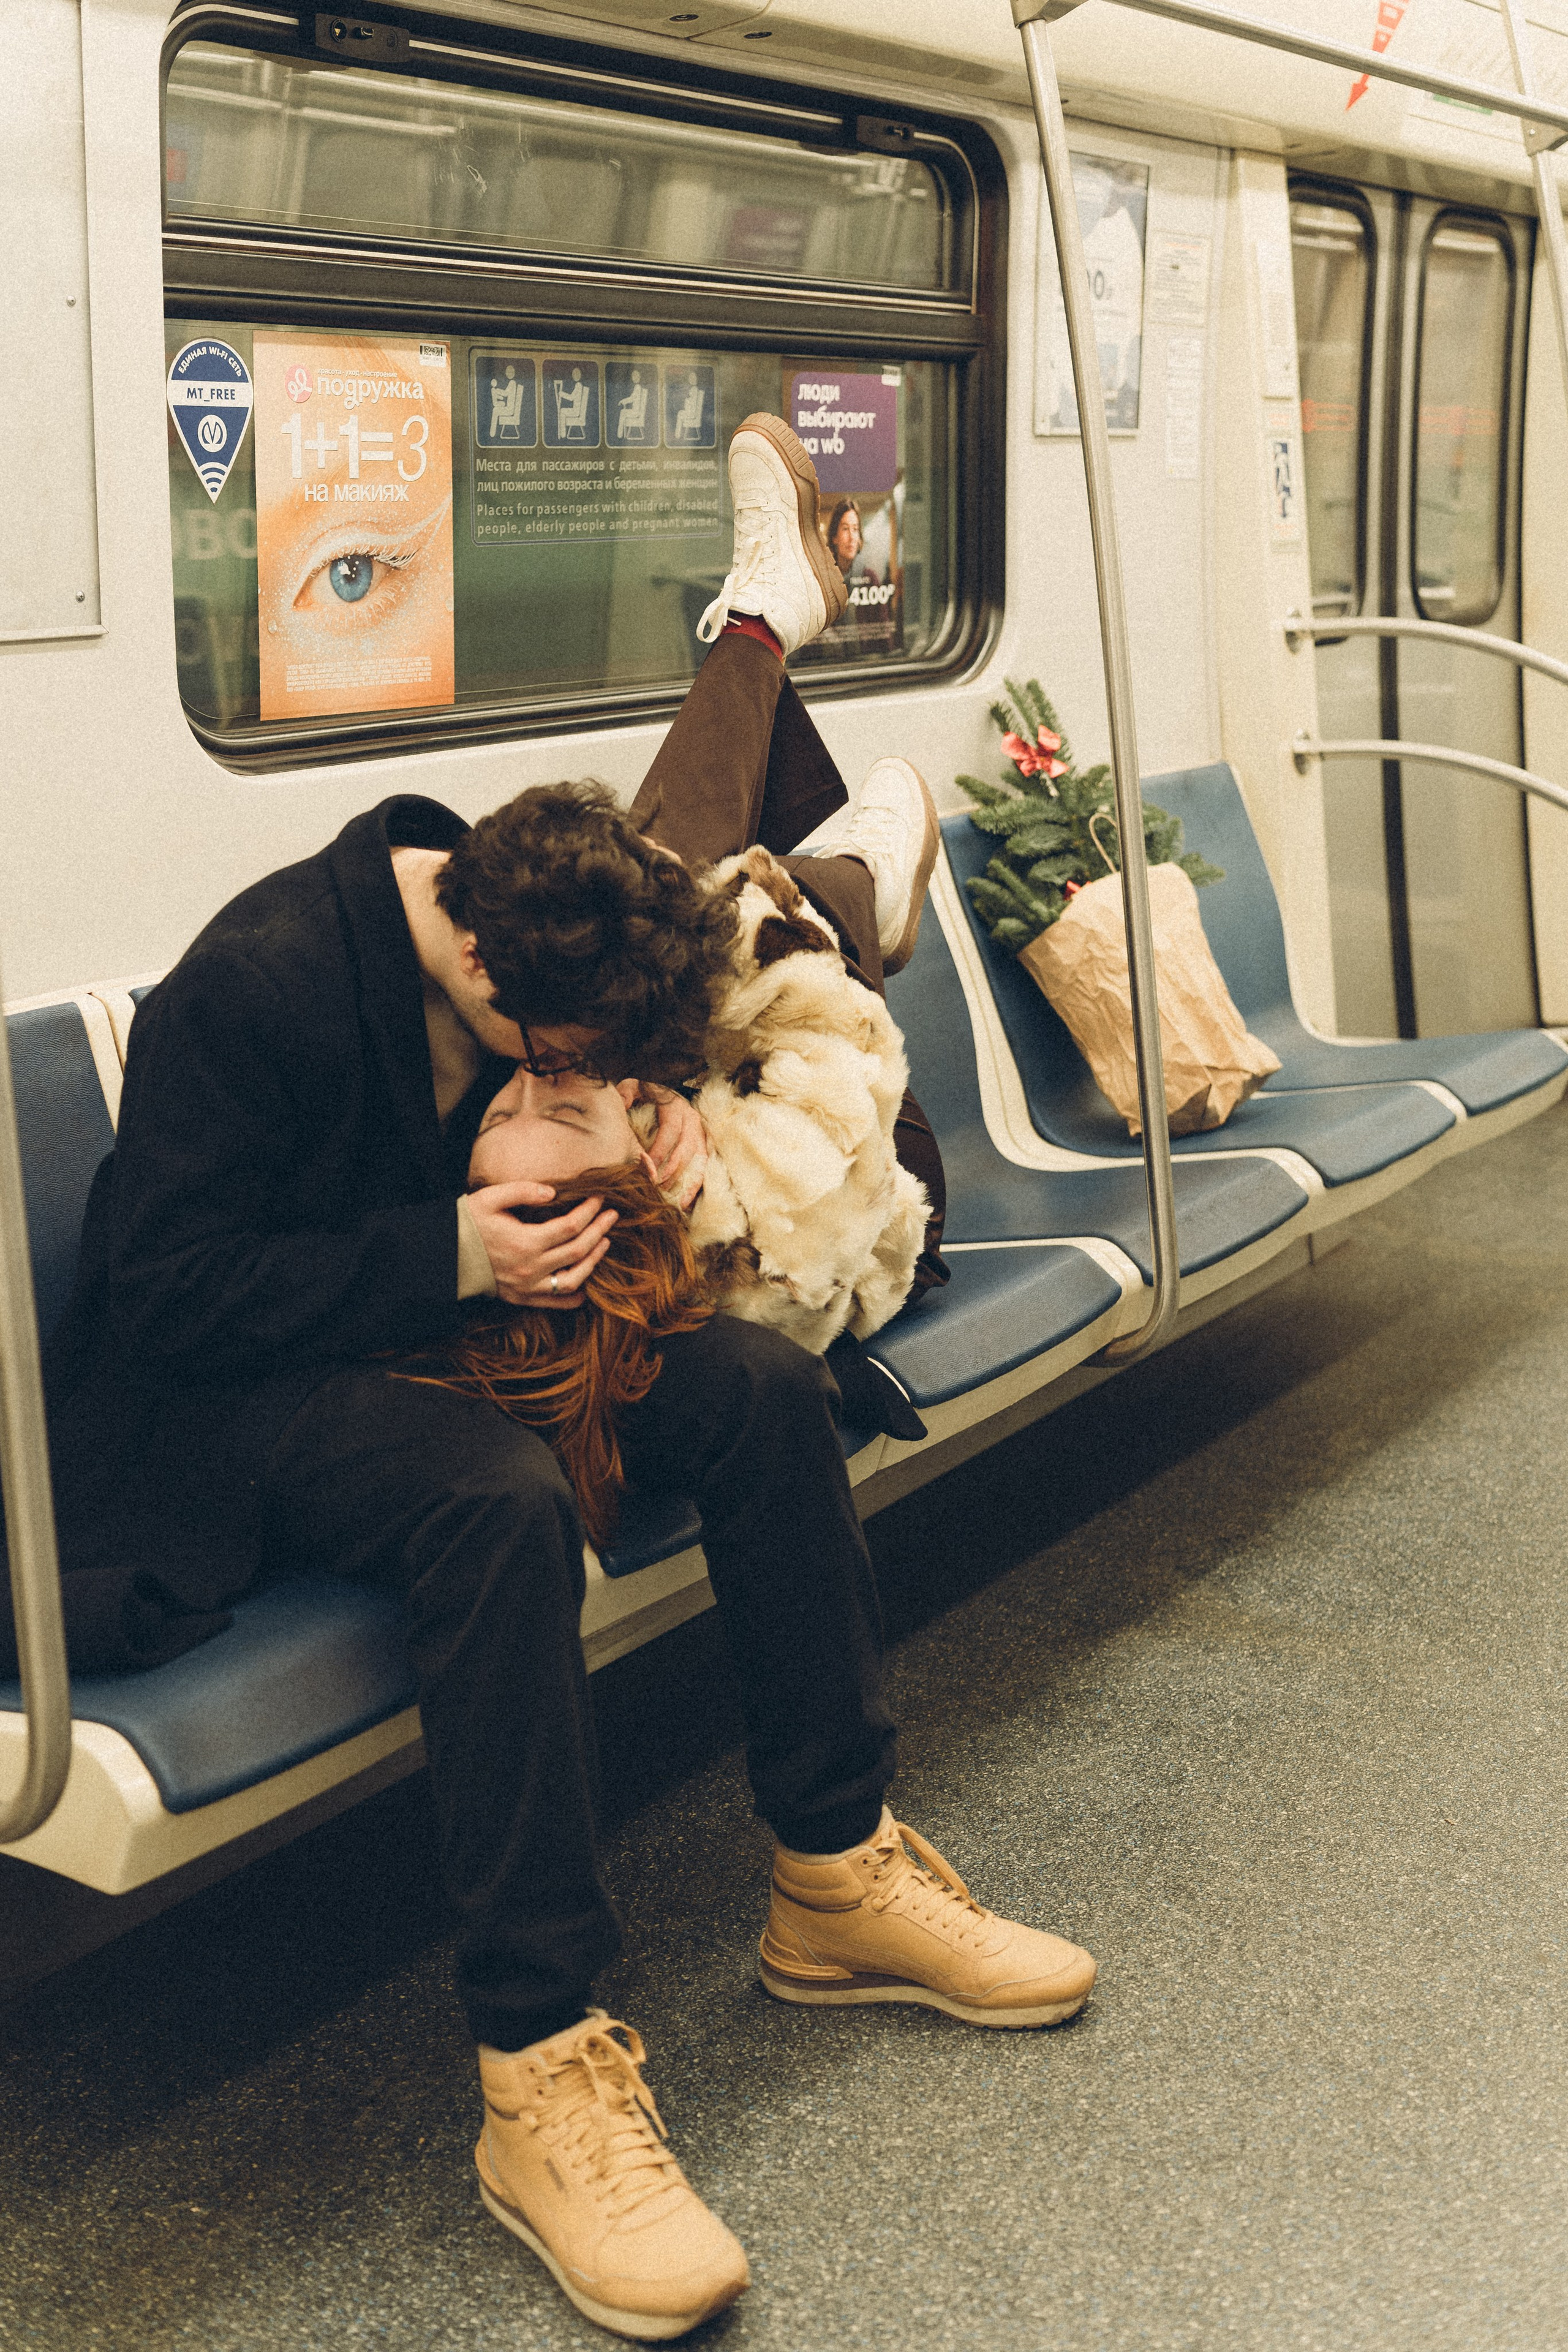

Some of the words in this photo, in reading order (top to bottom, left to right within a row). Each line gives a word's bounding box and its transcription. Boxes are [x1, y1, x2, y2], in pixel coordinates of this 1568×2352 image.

[178, 347, 207, 374] ЕДИНАЯ
[209, 346, 228, 360] WI-FI
[228, 357, 242, 377] СЕТЬ
[187, 387, 235, 402] MT_FREE
[317, 377, 424, 410] подружка
[797, 383, 840, 404] люди
[797, 405, 876, 433] выбирают
[281, 413, 429, 482] 1+1=3
[476, 459, 511, 471] Места
[516, 461, 537, 473] для
[542, 461, 605, 474] пассажиров
[609, 461, 615, 470] с
[619, 461, 658, 472] детьми,
[304, 483, 329, 502] на
[334, 483, 409, 502] макияж
[477, 481, 499, 494] лиц
[501, 480, 555, 491] пожилого
[557, 480, 603, 493] возраста
[605, 480, 612, 489] и
[614, 476, 677, 492] беременных
[477, 504, 514, 516] Places
[517, 502, 535, 515] for
[537, 503, 598, 518] passengers
[601, 500, 627, 513] with
[628, 499, 674, 513] children,
[676, 498, 718, 511] disabled
[478, 521, 521, 537] people,
[526, 520, 565, 535] elderly
[568, 519, 605, 533] people
[609, 517, 629, 530] and
[632, 518, 680, 532] pregnant
